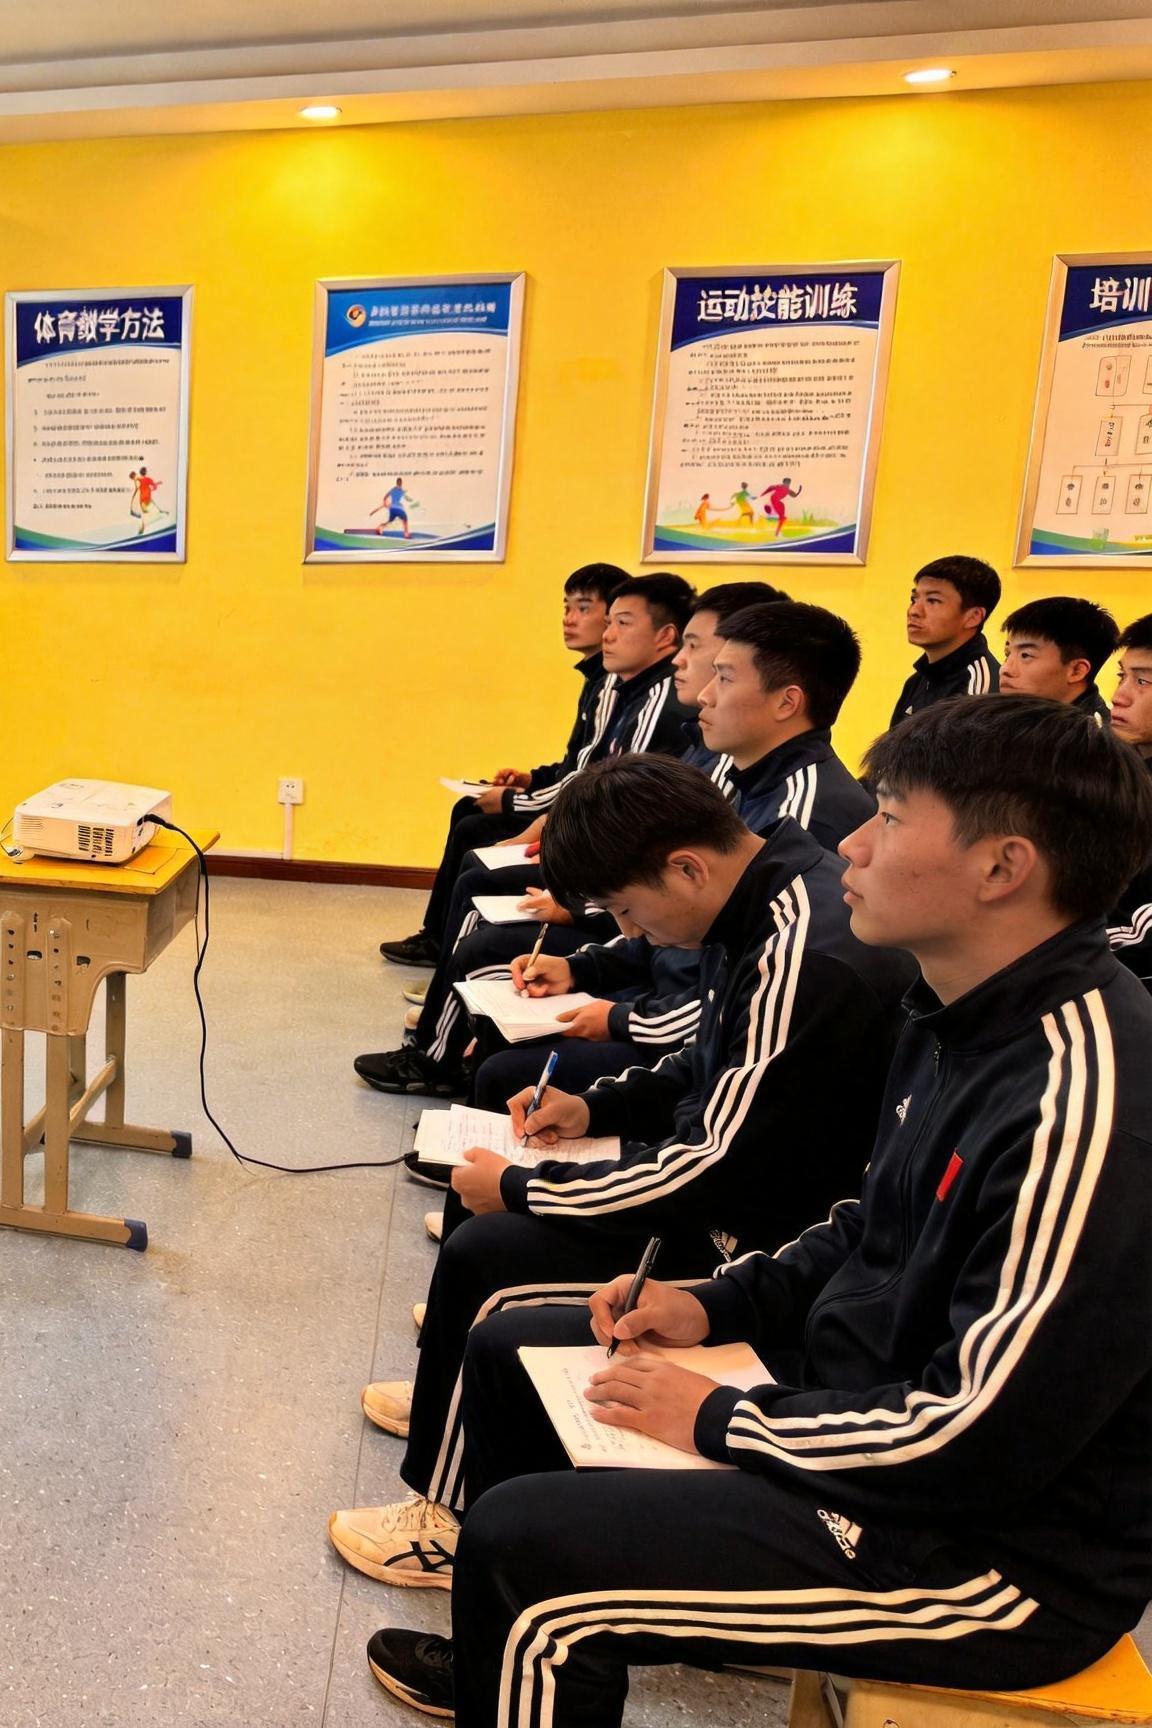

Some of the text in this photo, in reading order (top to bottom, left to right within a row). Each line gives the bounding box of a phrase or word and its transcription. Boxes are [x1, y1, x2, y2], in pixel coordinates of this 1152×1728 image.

[697, 282, 858, 322] 运动技能训练
